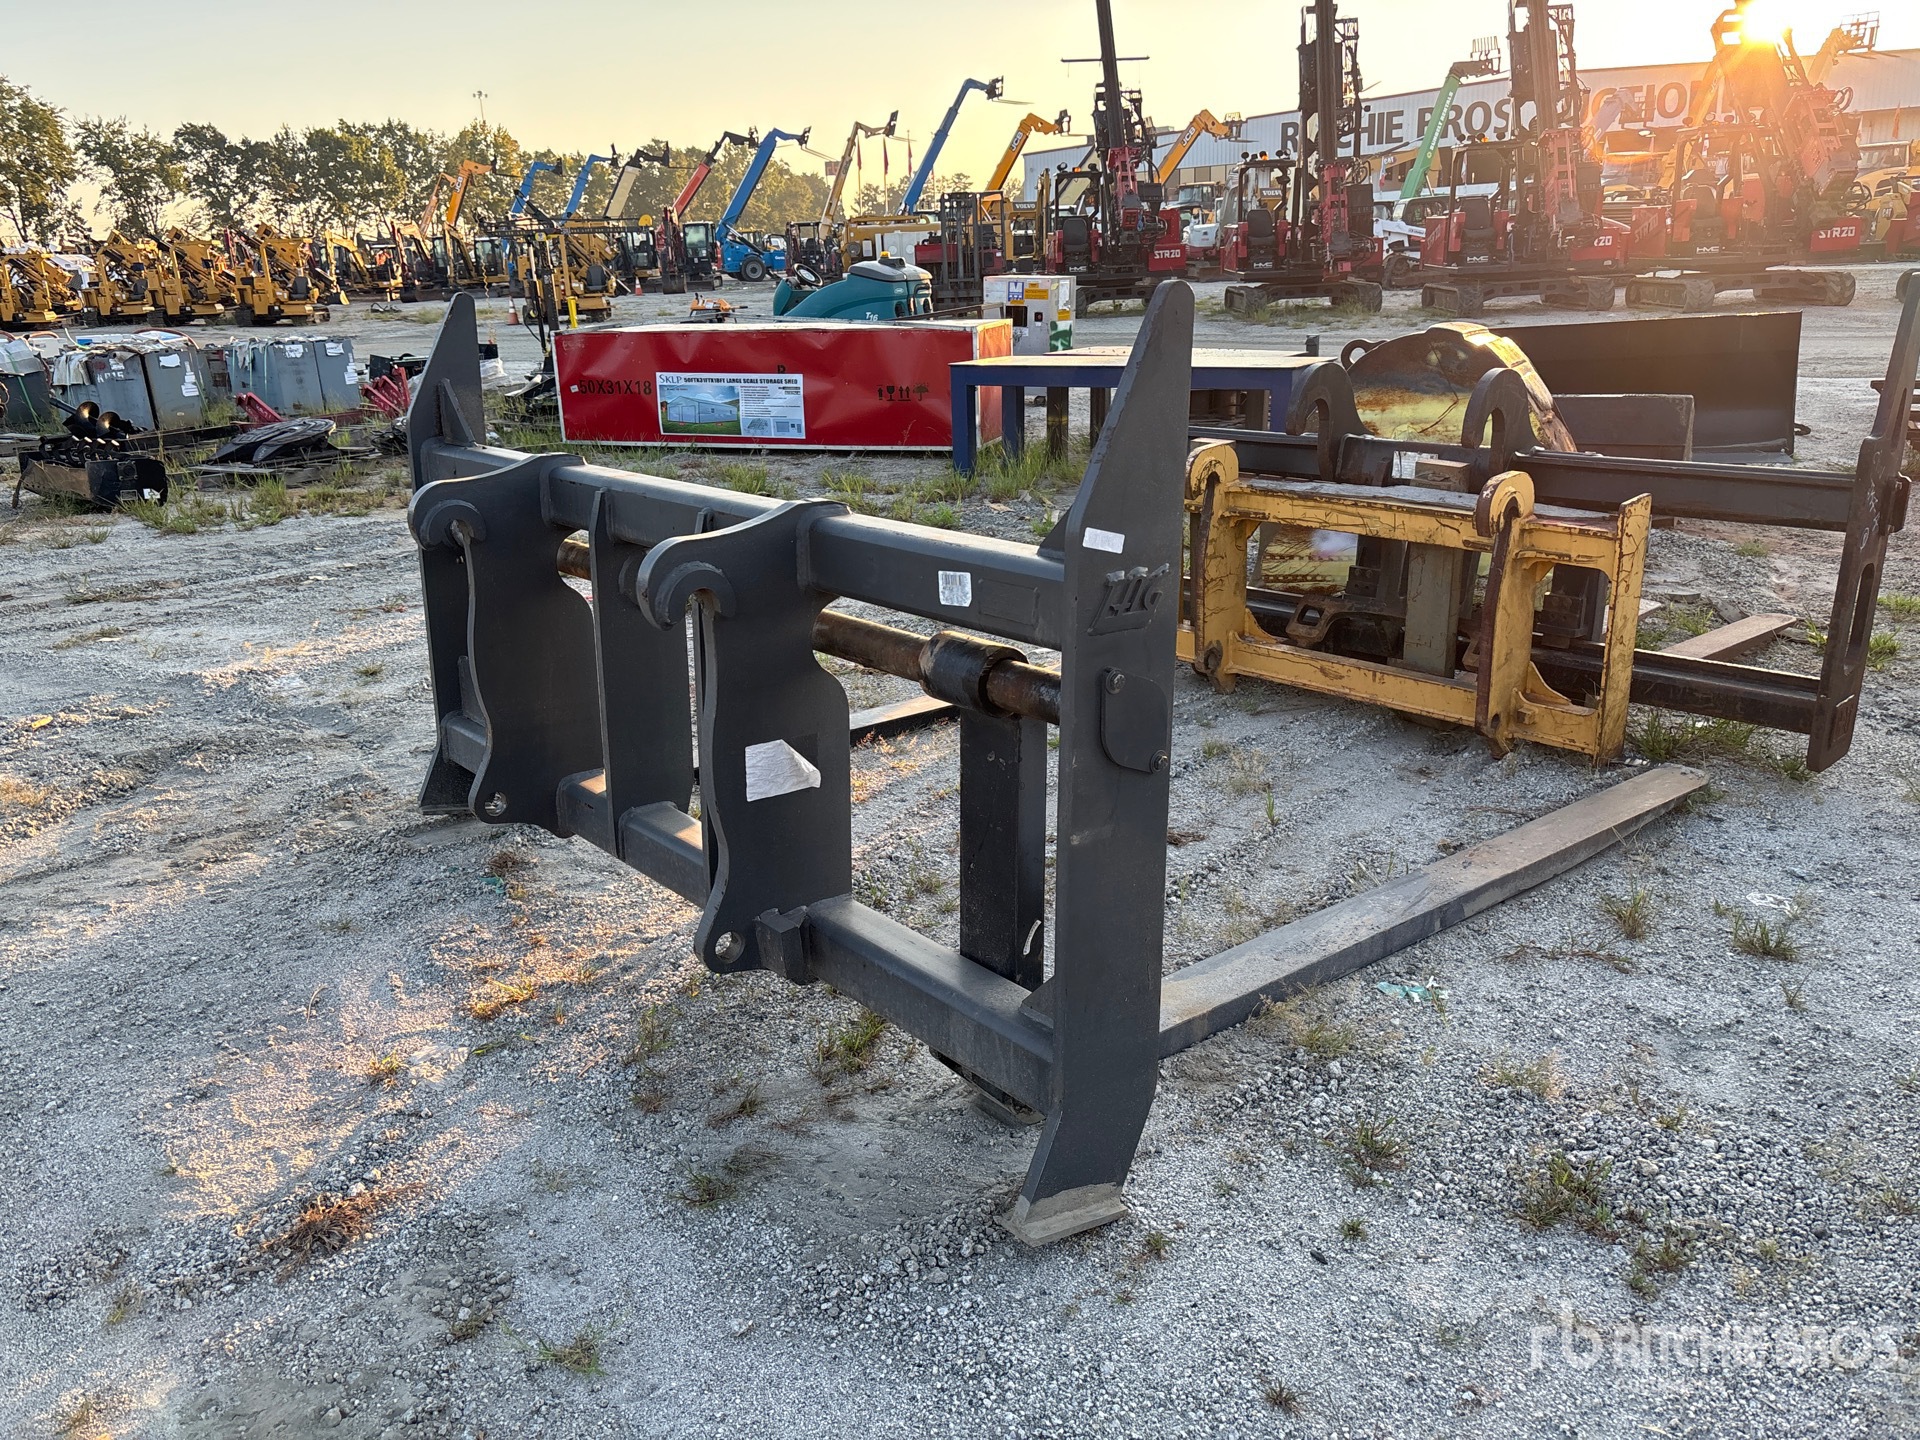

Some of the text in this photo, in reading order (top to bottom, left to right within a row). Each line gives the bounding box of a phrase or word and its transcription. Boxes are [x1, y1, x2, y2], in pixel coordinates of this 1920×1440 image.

[1011, 131, 1023, 151] JCB
[1183, 126, 1196, 146] JCB
[1882, 208, 1893, 217] CAT
[1818, 227, 1856, 238] STR20
[1154, 249, 1181, 259] STR20
[865, 311, 879, 322] T16
[659, 373, 682, 384] SKLP
[580, 379, 652, 395] 50X31X18
